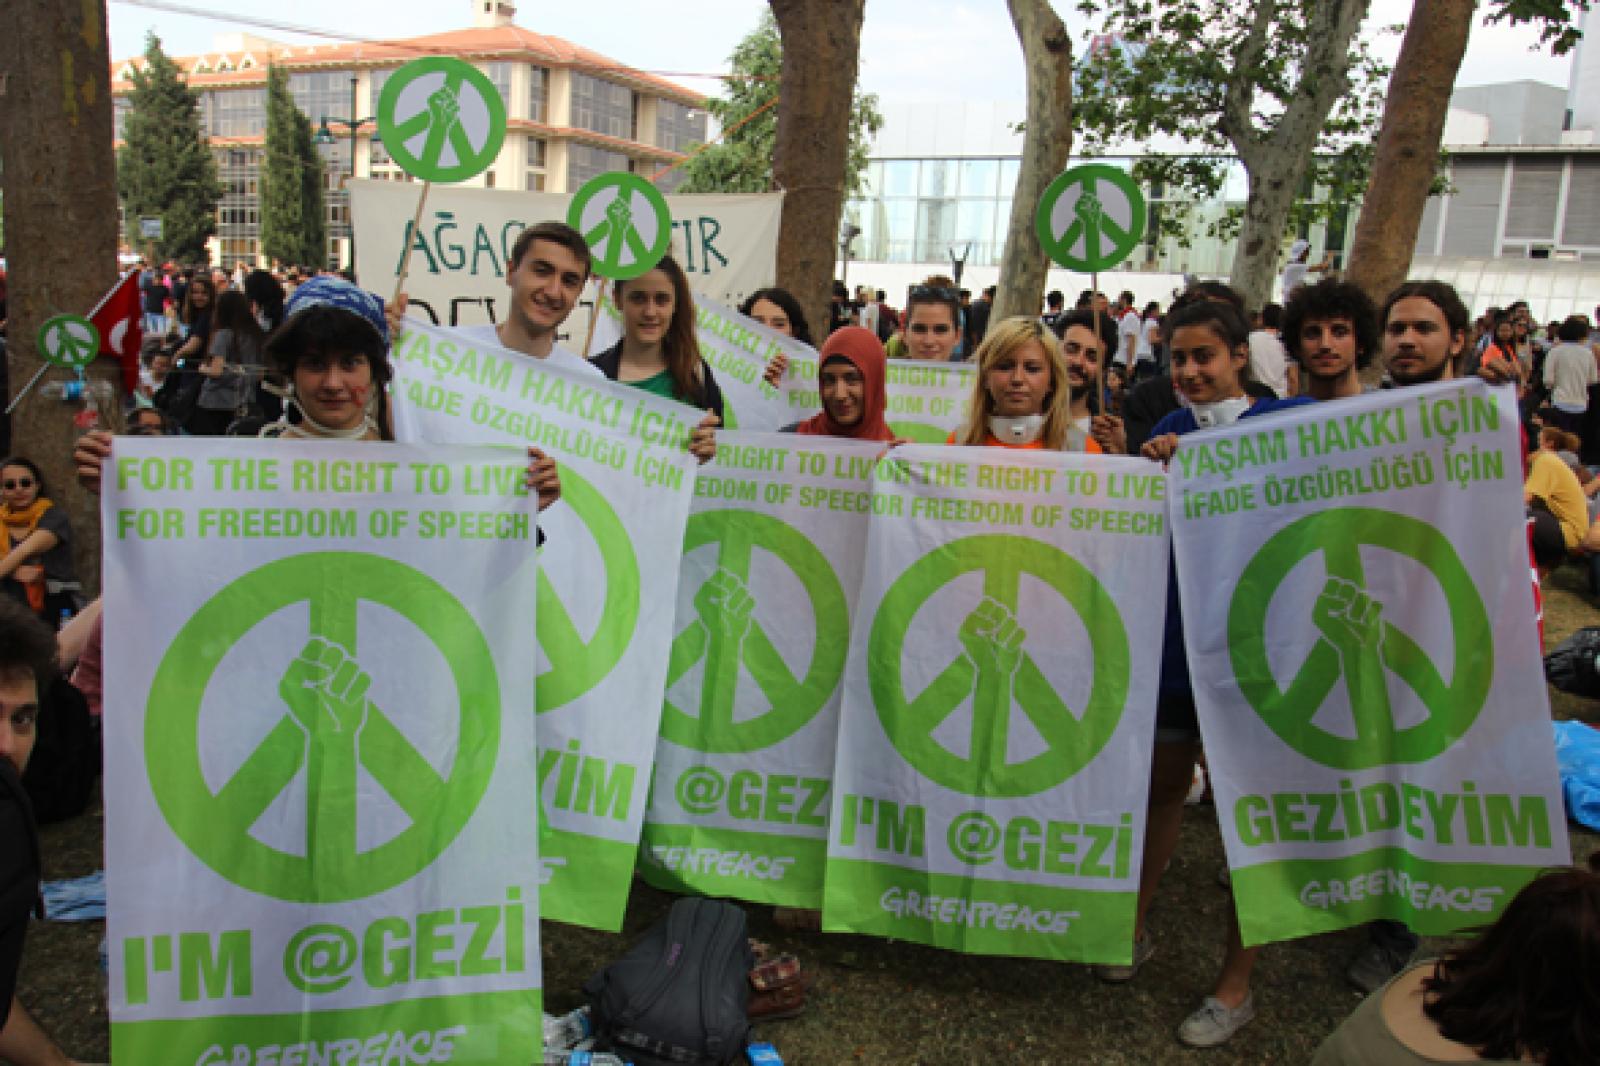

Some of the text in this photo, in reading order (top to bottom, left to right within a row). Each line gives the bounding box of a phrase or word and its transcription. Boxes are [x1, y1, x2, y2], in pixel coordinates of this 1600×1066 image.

[789, 358, 819, 380] FO
[393, 329, 698, 453] YAŞAM HAKKI İÇİN
[1177, 388, 1500, 480] YAŞAM HAKKI İÇİN
[117, 457, 529, 498] FOR THE RIGHT TO LIVE
[632, 449, 684, 492] İÇİN
[716, 445, 874, 481] RIGHT TO LIV
[876, 458, 1168, 501] OR THE RIGHT TO LIVE
[1183, 445, 1504, 520] İFADE ÖZGÜRLÜĞÜ İÇİN
[694, 476, 870, 514] EDOM OF SPEEC
[872, 494, 1165, 535] OR FREEDOM OF SPEECH
[117, 508, 530, 540] FOR FREEDOM OF SPEECH
[674, 765, 829, 827] @GEZ
[1234, 778, 1553, 849] GEZİDEYİM
[839, 793, 1134, 881] I'M @GEZİ
[880, 886, 1081, 934] GREENPEACE
[1301, 869, 1504, 913] GREENEACE
[122, 885, 525, 1005] I'M @GEZİ
[194, 1024, 467, 1066] GREENPEACE
